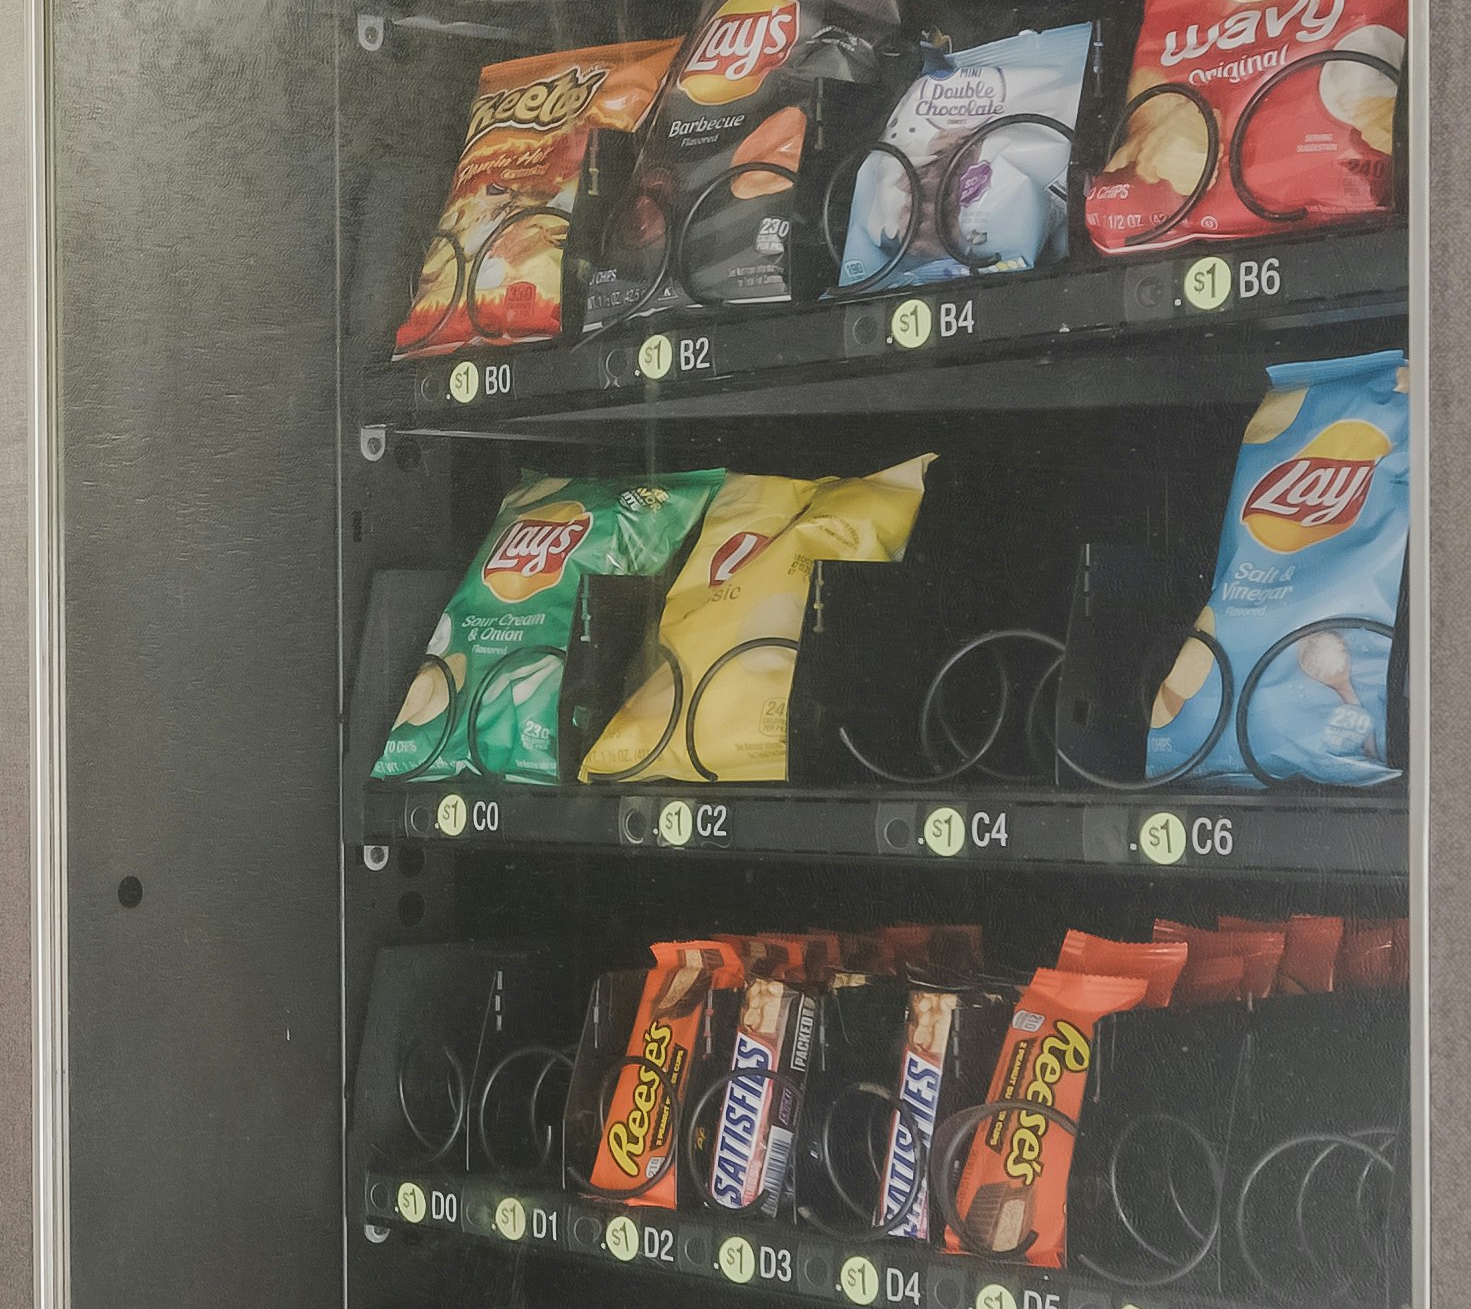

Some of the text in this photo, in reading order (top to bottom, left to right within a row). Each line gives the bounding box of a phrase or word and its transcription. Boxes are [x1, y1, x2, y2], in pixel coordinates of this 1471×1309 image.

[683, 4, 793, 81] Lay's
[958, 67, 983, 80] MINI
[1187, 43, 1288, 85] Original
[931, 81, 995, 101] Double
[669, 113, 745, 139] Barbecue
[914, 100, 1005, 120] Chocolate
[1097, 184, 1131, 201] CHIPS
[759, 217, 790, 238] 230
[1193, 258, 1281, 299] $1 B6
[900, 301, 975, 338] $1 B4
[644, 338, 711, 370] $1 B2
[454, 364, 511, 395] $1 B0
[1252, 460, 1371, 527] Lay
[487, 518, 585, 578] Lay's
[1234, 562, 1295, 583] Salt &
[1221, 580, 1294, 608] Vinegar
[462, 612, 545, 628] Sour Cream
[480, 627, 523, 642] Onion
[524, 721, 551, 739] 230
[1330, 706, 1370, 736] 230
[442, 800, 499, 832] $1 C0
[664, 804, 727, 843] $1 C2
[932, 811, 1009, 848] $1 C4
[1148, 818, 1234, 856] $1 C6
[608, 1021, 673, 1177] Reese's
[1006, 1020, 1090, 1186] Reese's
[402, 1189, 456, 1222] $1 D0
[501, 1204, 557, 1240] $1 D1
[611, 1221, 674, 1261] $1 D2
[726, 1244, 793, 1283] $1 D3
[847, 1263, 921, 1306] $1 D4
